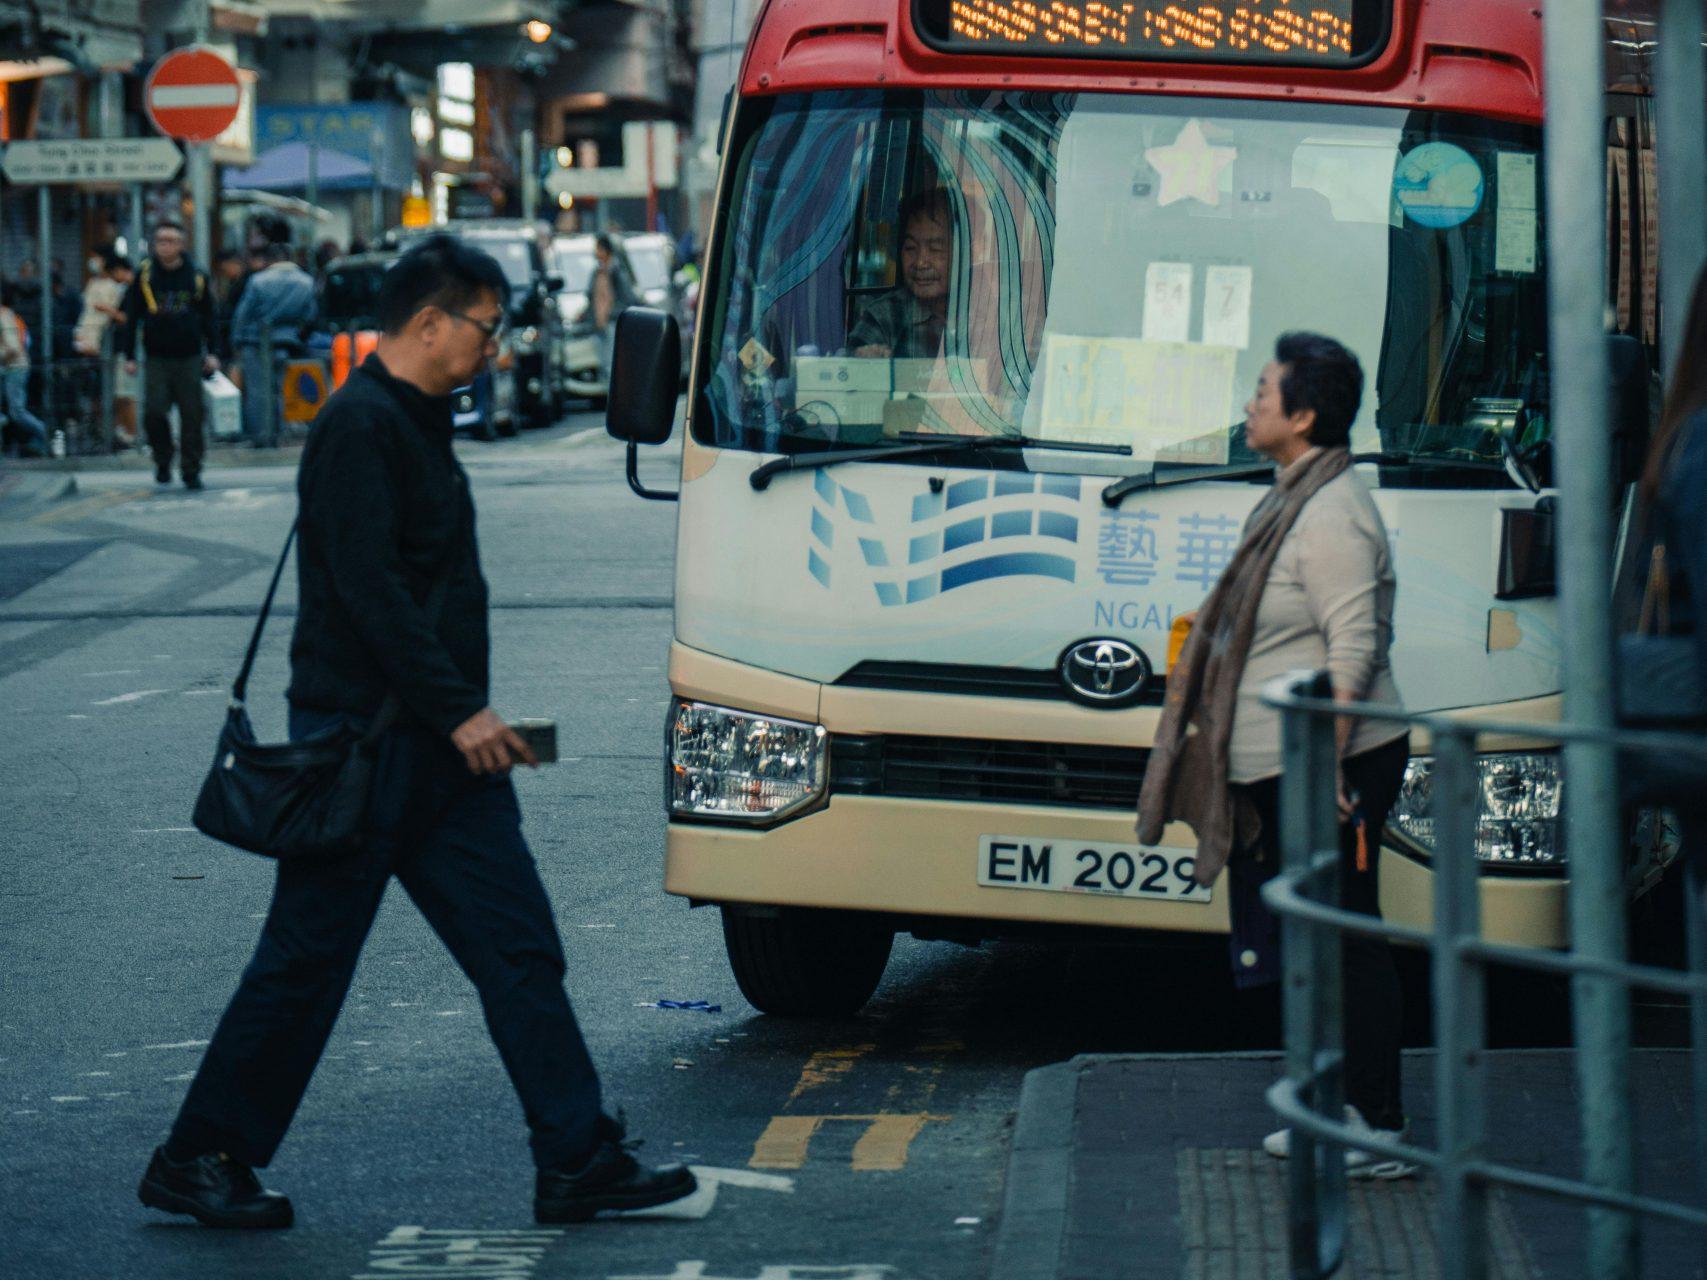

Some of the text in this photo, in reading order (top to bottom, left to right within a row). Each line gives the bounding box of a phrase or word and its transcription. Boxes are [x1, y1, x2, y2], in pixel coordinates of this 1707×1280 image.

[988, 842, 1199, 895] EM 2029
[352, 1225, 565, 1280] IGHT
